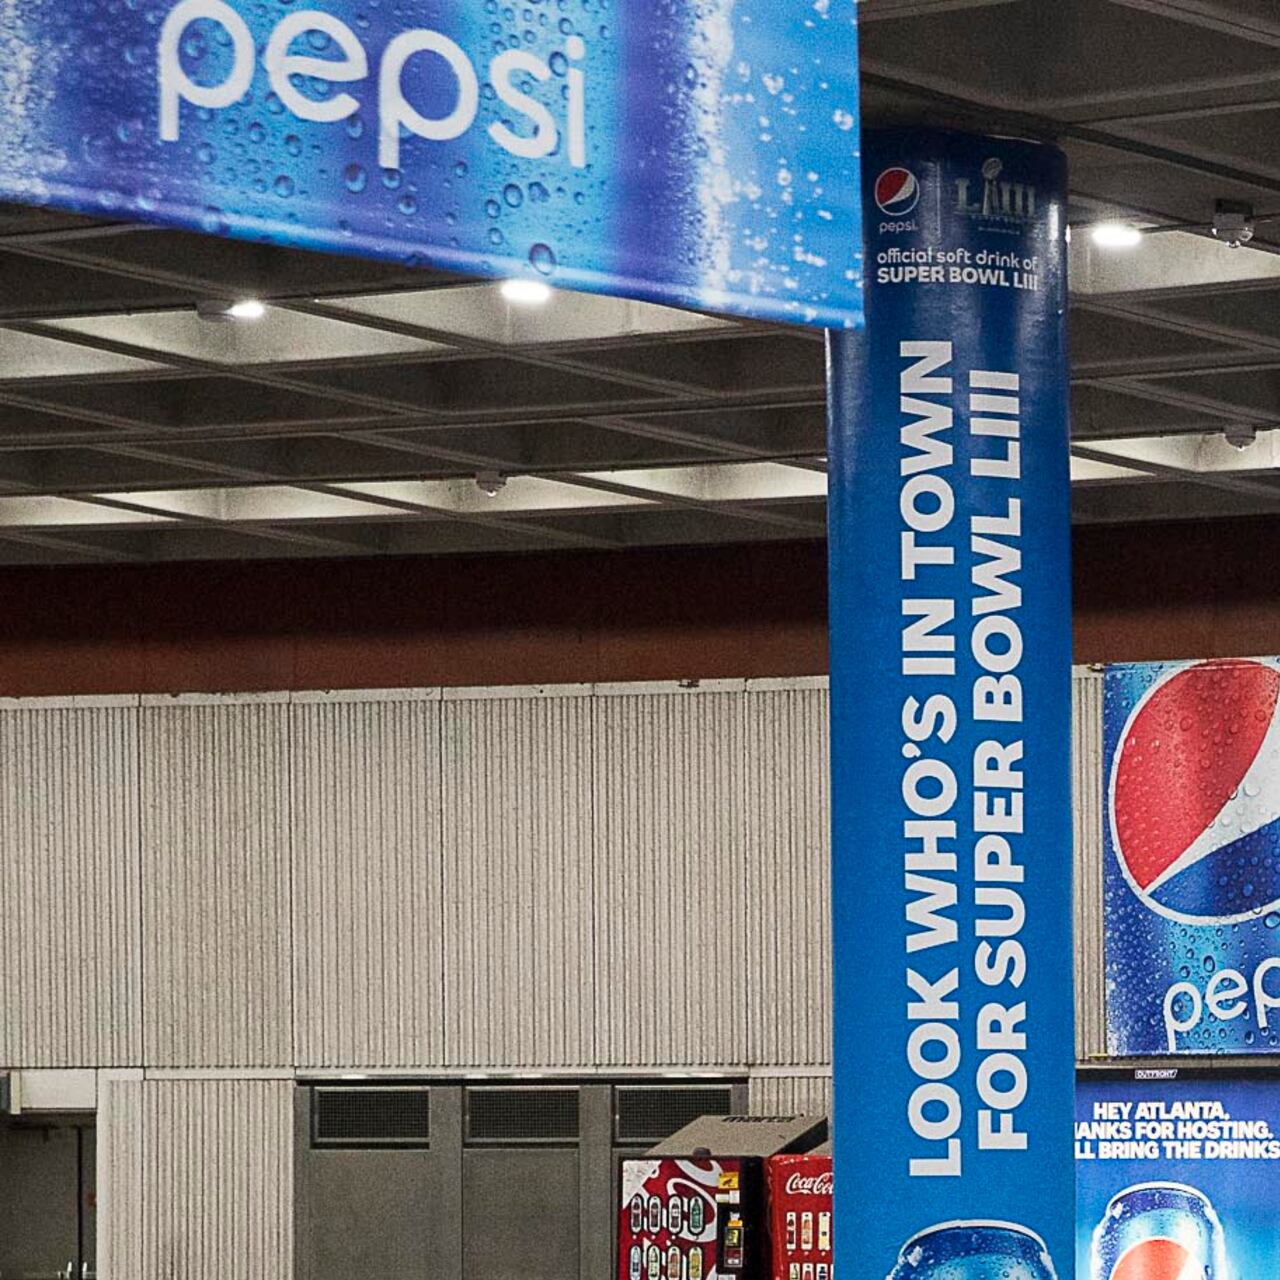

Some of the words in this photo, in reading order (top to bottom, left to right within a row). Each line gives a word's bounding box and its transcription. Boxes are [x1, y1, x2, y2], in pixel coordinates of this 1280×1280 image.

[158, 0, 586, 168] pepsi
[876, 247, 933, 265] official
[936, 247, 972, 264] soft
[975, 250, 1020, 269] drink
[1022, 255, 1039, 271] of
[876, 266, 946, 284] SUPER
[948, 267, 1010, 288] BOWL
[1012, 273, 1039, 291] LIII
[899, 340, 955, 580] TOWN
[968, 369, 1021, 479] LIII
[901, 598, 956, 676] IN
[969, 497, 1024, 722] BOWL
[901, 693, 959, 953] WHO'S
[972, 740, 1027, 989] SUPER
[906, 967, 962, 1177] LOOK
[975, 1000, 1029, 1150] FOR
[1093, 1101, 1133, 1120] HEY
[1135, 1121, 1175, 1140] FOR
[1177, 1120, 1274, 1140] HOSTING.
[1098, 1141, 1160, 1160] BRING
[1162, 1141, 1202, 1160] THE
